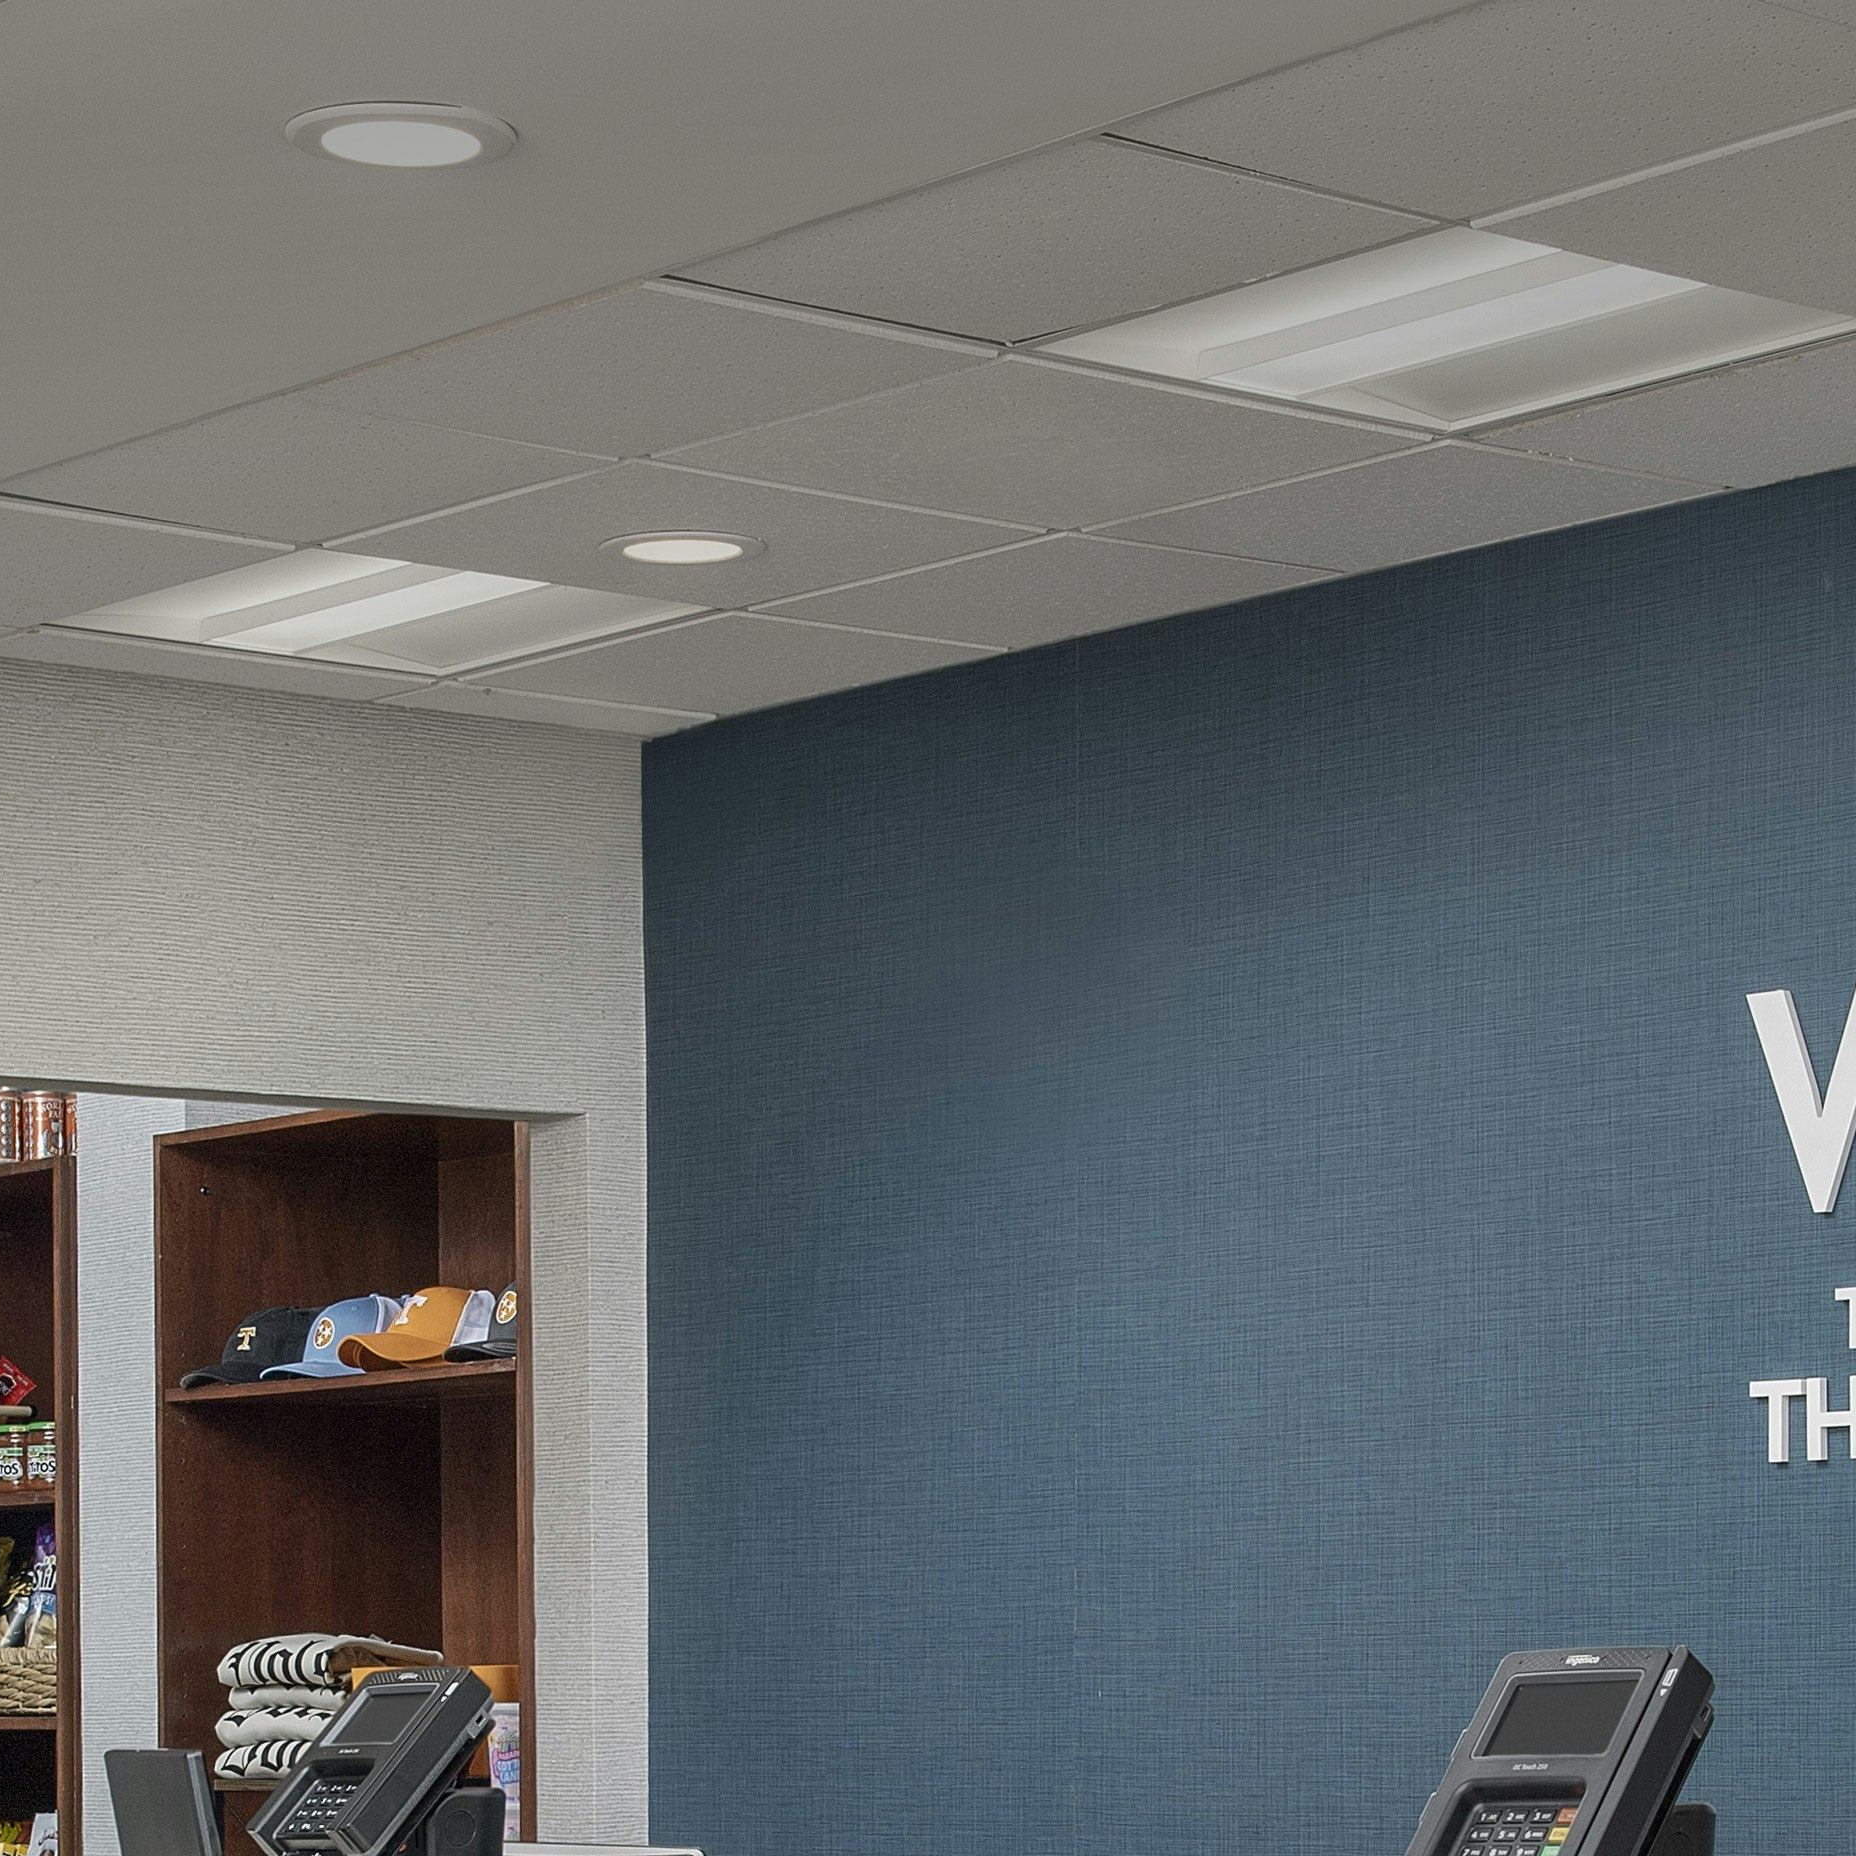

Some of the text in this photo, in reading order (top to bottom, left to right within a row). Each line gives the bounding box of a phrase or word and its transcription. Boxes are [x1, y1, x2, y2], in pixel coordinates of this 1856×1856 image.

[1506, 1813, 1514, 1821] 2
[1533, 1812, 1541, 1821] 3
[1498, 1831, 1506, 1839] 5
[1525, 1831, 1532, 1839] 6
[1489, 1848, 1497, 1856] 8
[1516, 1848, 1524, 1856] 9
